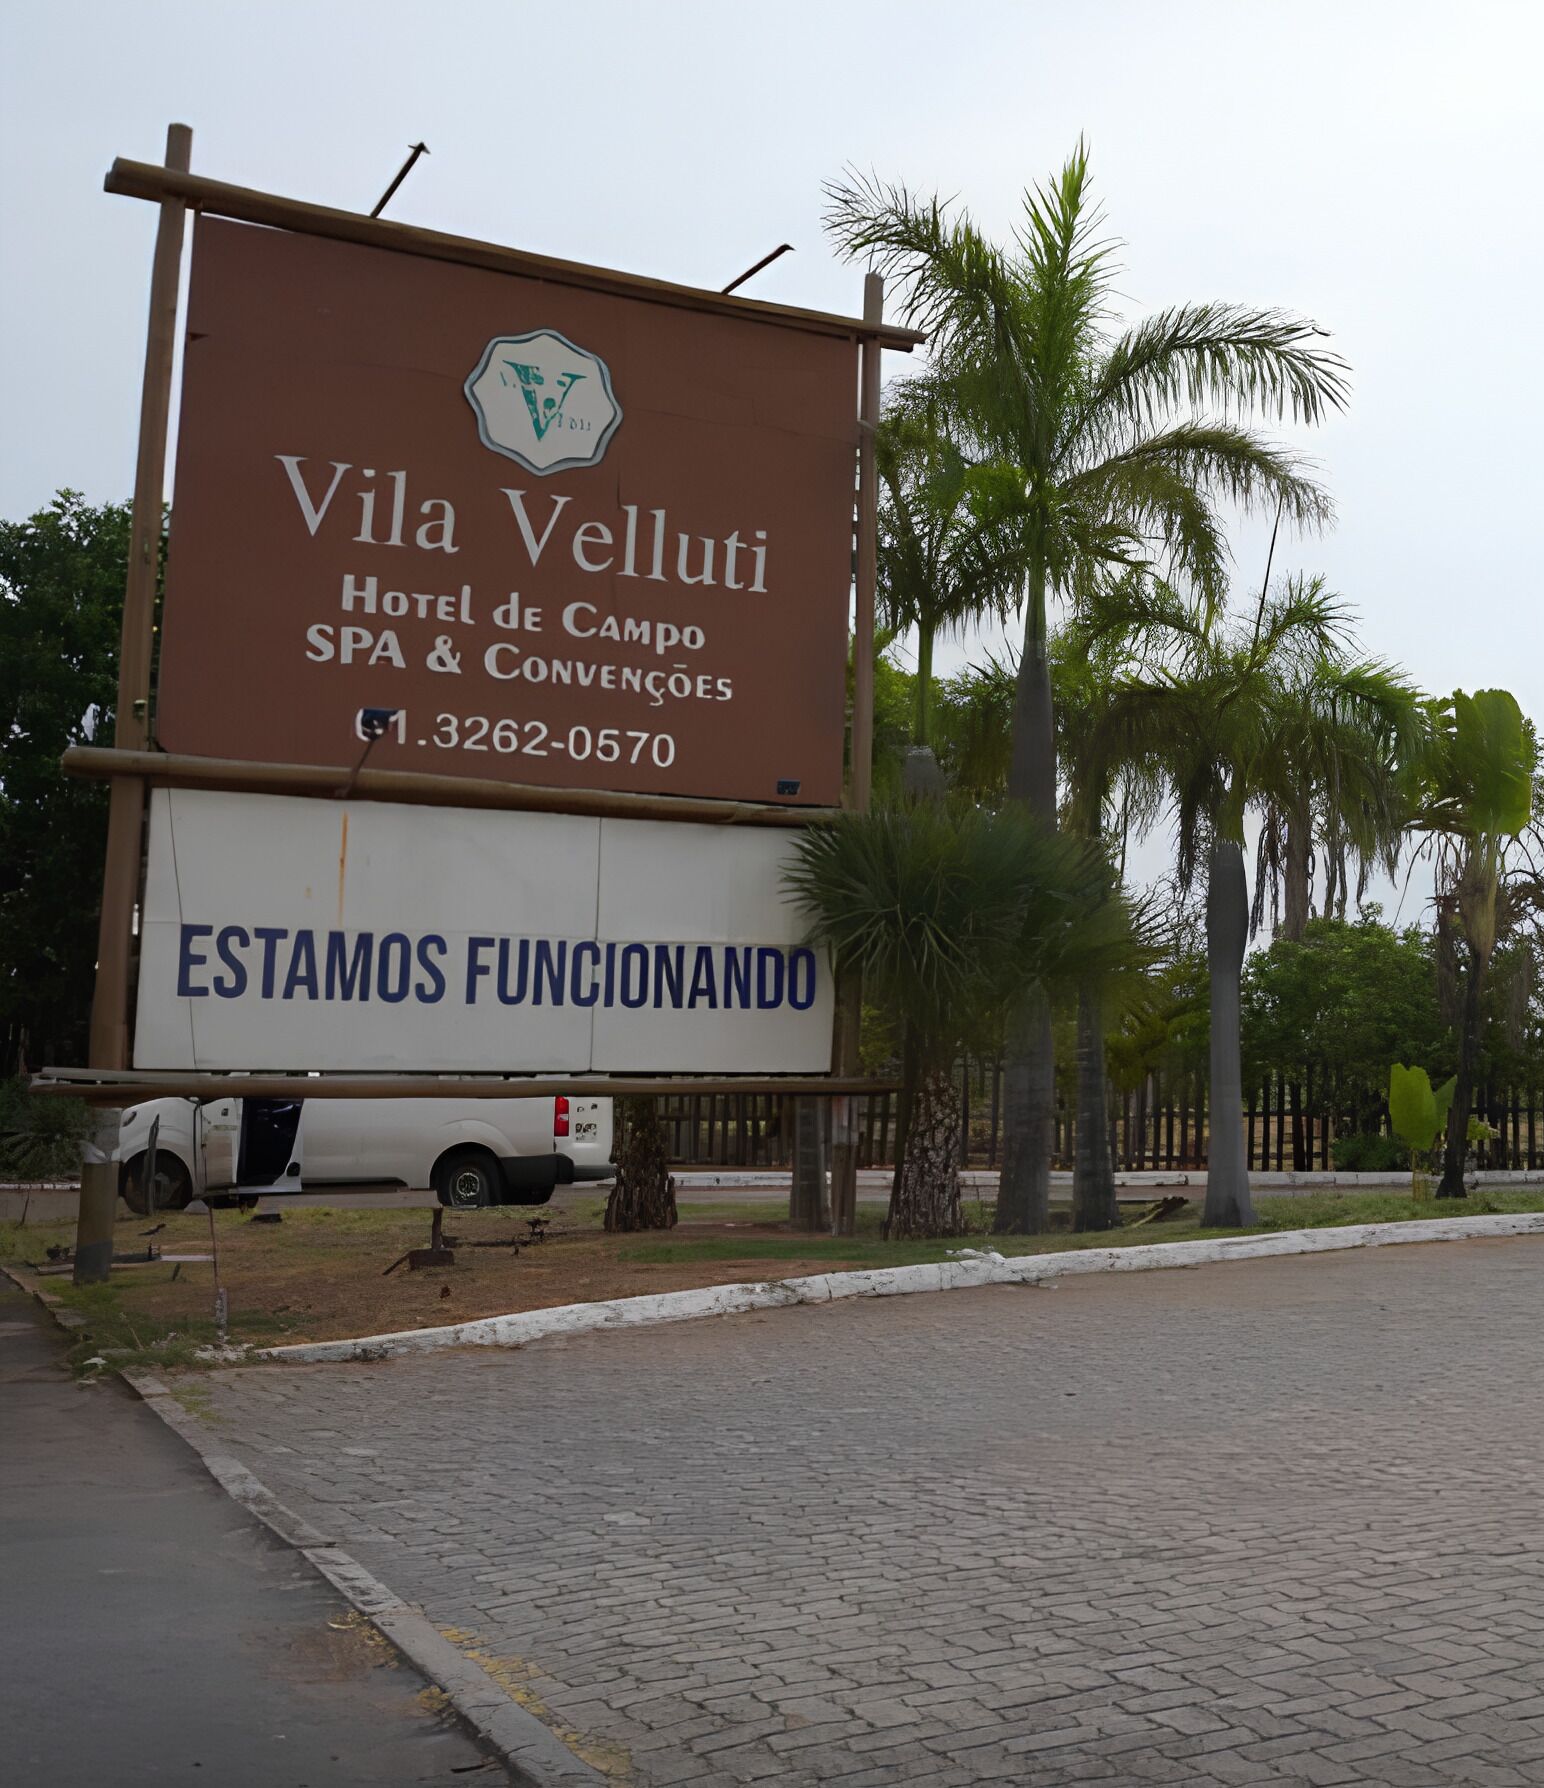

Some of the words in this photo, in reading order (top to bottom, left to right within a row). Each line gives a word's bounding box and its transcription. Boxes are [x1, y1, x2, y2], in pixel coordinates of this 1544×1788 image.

[274, 455, 460, 555] Vila
[500, 487, 769, 594] Velluti
[305, 623, 407, 669] SPA
[425, 634, 463, 675] &
[176, 922, 448, 1005] ESTAMOS
[465, 936, 818, 1012] FUNCIONANDO
